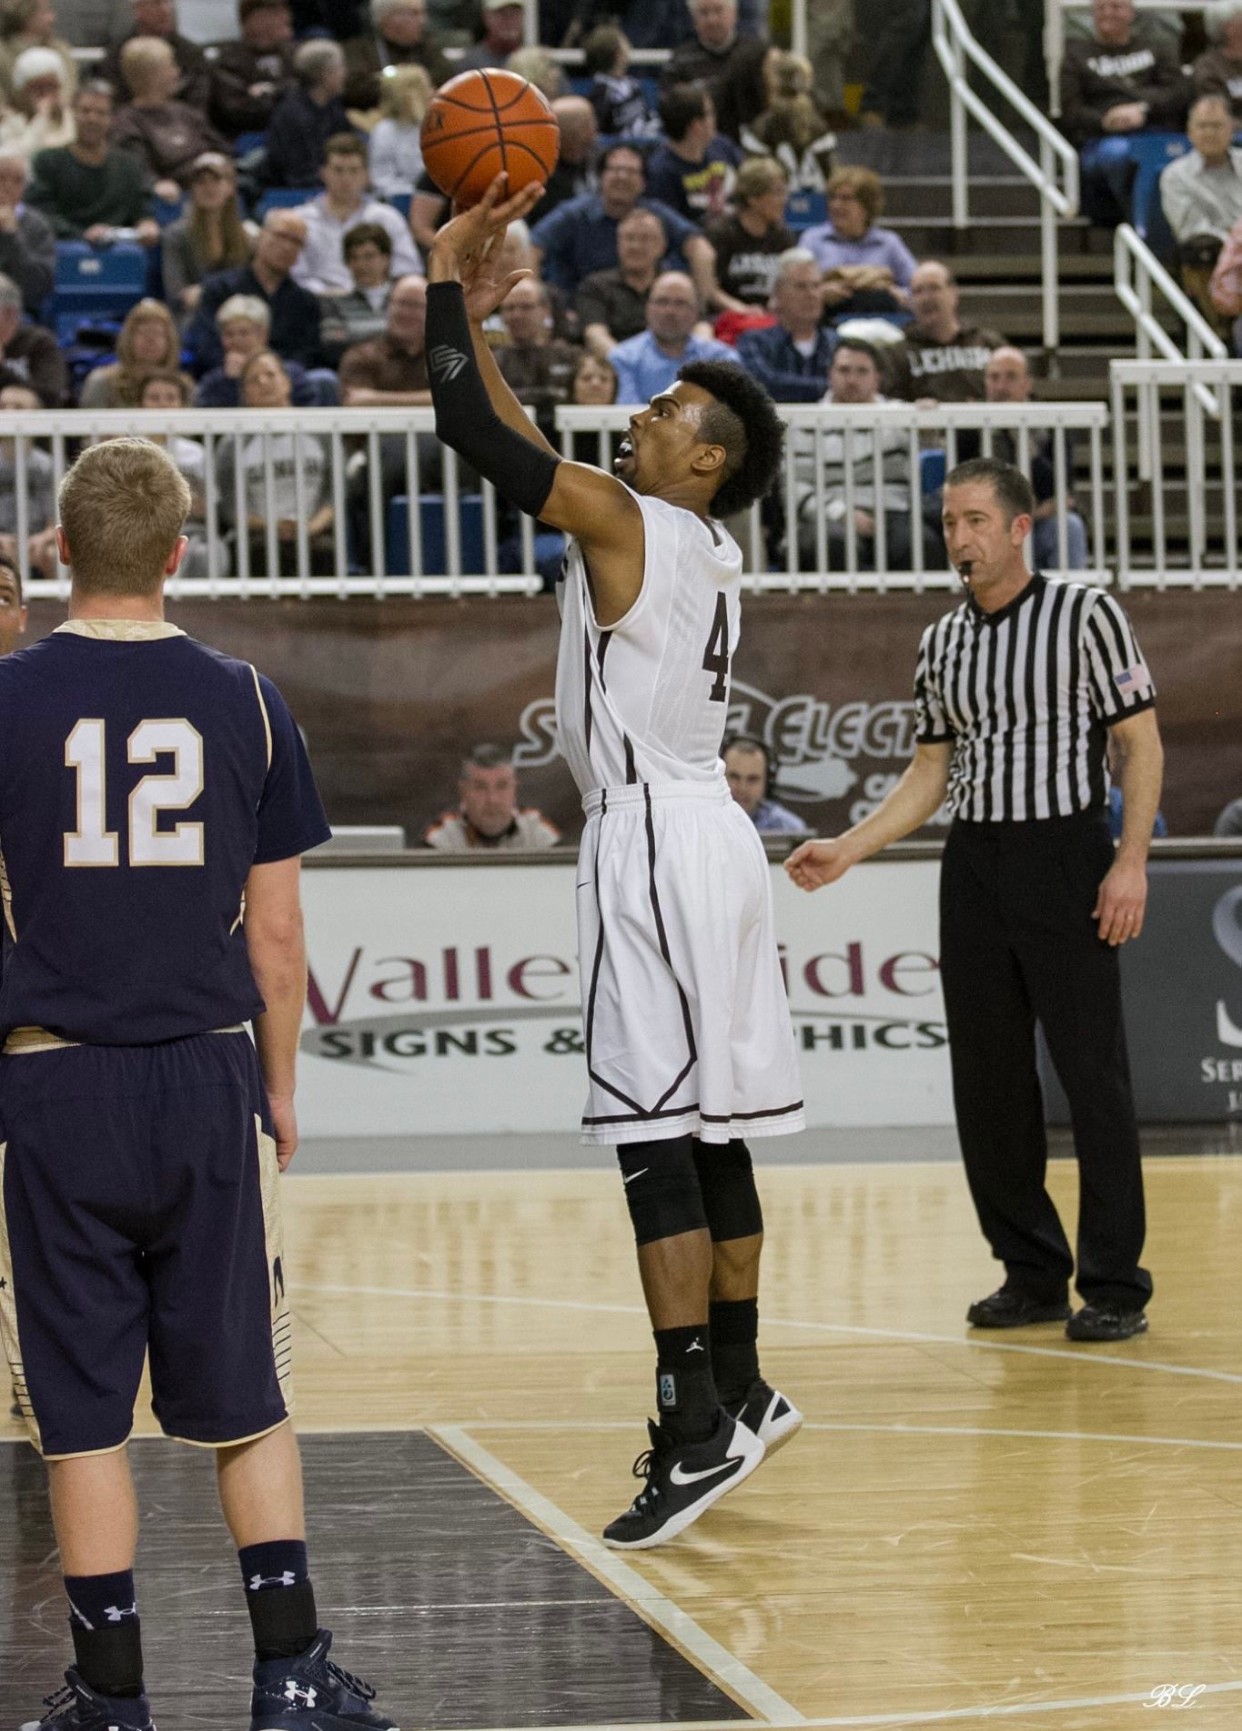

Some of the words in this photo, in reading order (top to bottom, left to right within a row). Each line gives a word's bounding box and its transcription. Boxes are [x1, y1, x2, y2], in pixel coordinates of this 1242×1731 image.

[702, 591, 728, 702] 4
[764, 695, 917, 765] ELECT
[63, 718, 204, 867] 12
[306, 945, 572, 1025] Valle
[777, 941, 940, 997] ide
[320, 1029, 516, 1059] SIGNS
[543, 1029, 586, 1055] &
[800, 1023, 948, 1050] HICS
